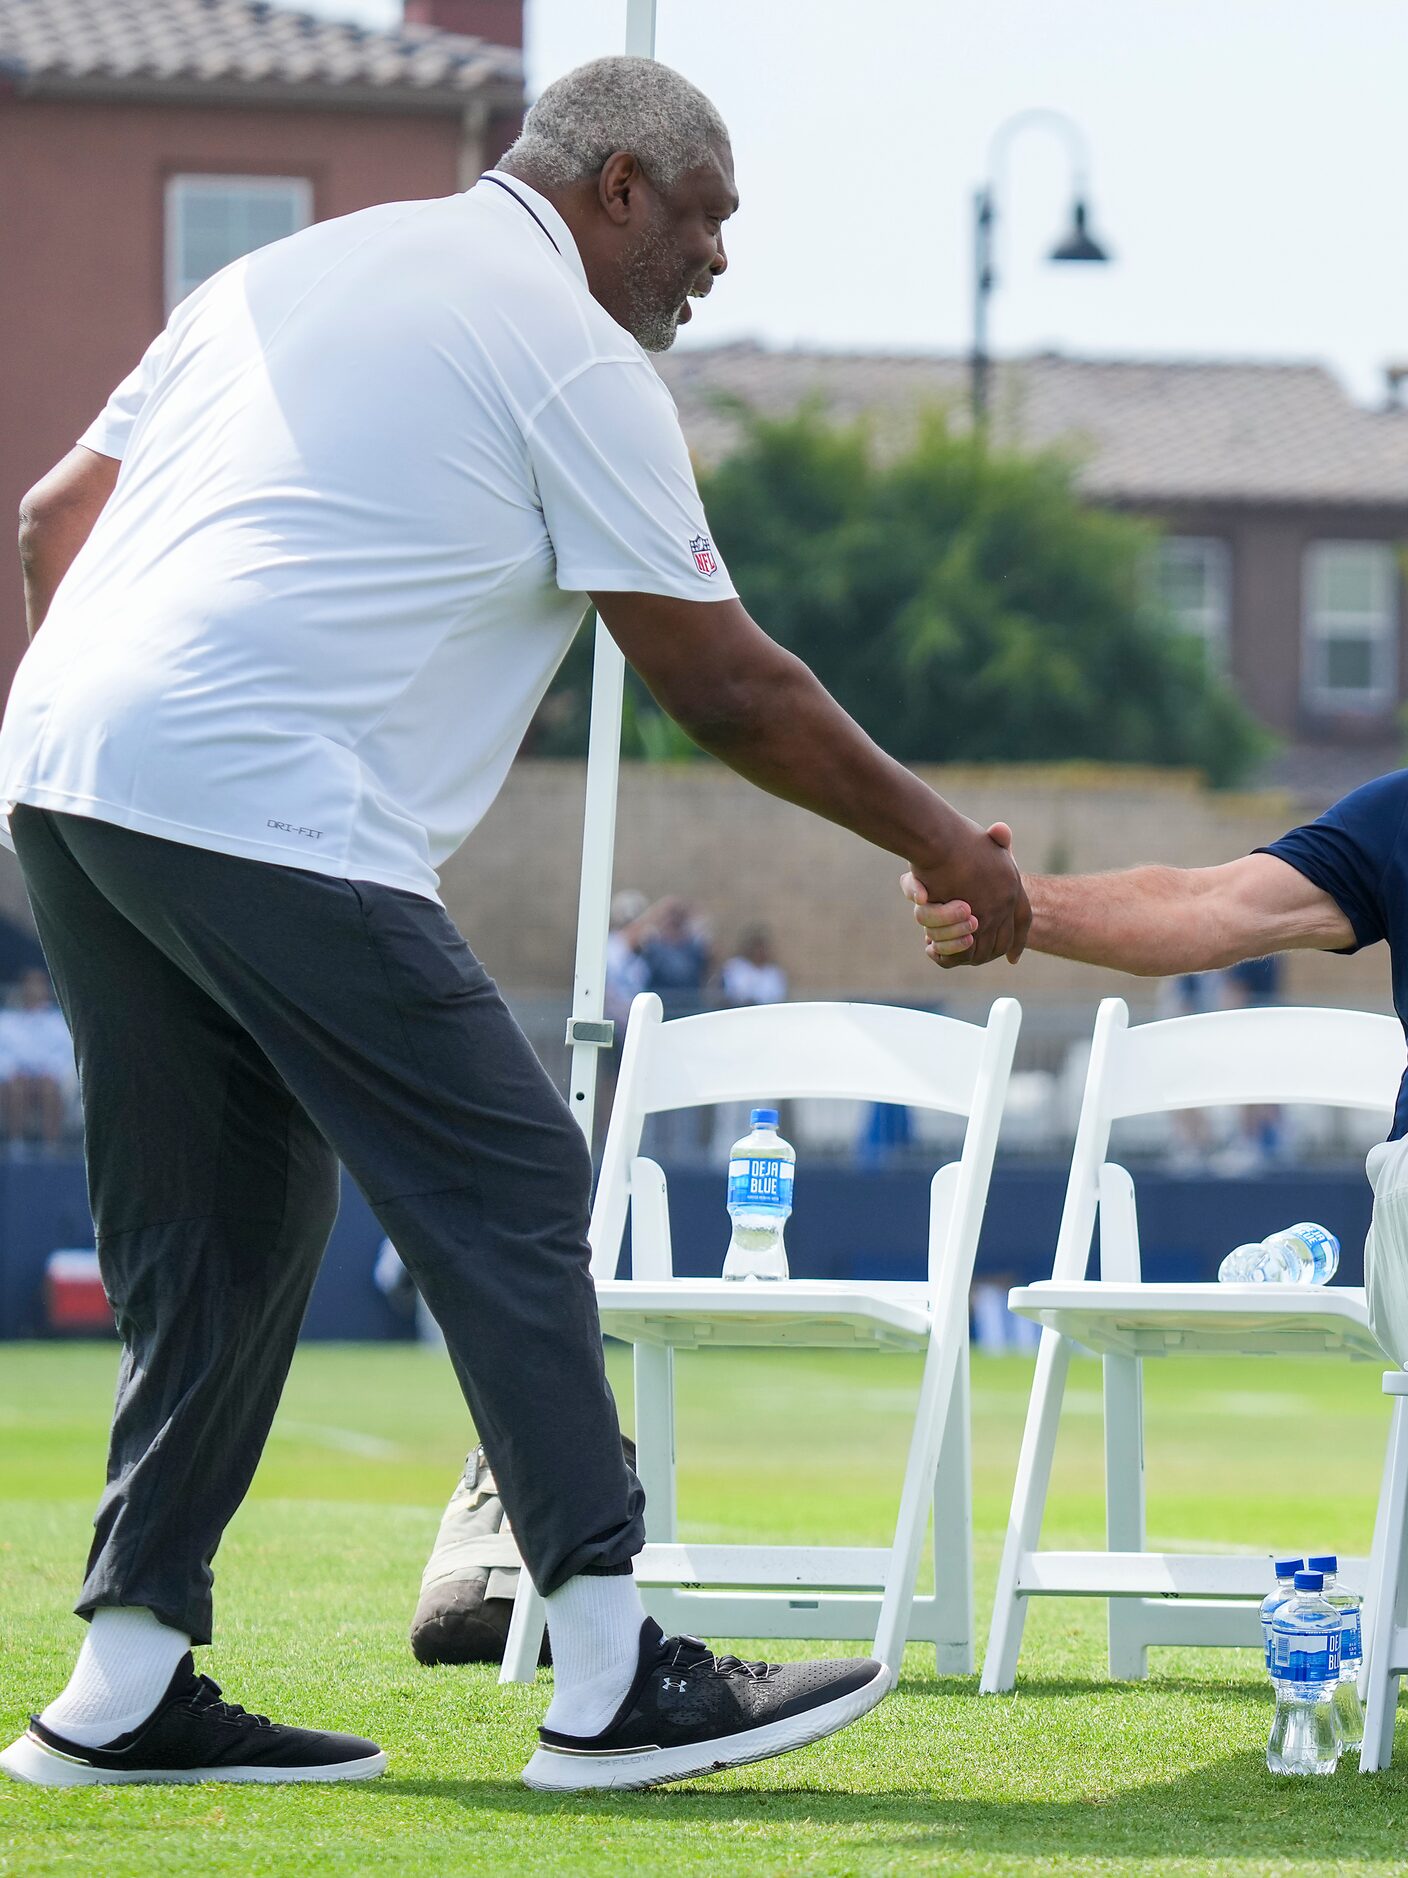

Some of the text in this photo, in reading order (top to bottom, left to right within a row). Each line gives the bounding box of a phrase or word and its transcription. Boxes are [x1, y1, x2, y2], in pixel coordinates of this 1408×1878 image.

[695, 552, 715, 572] NFL
[267, 819, 324, 839] DRI-FIT
[751, 1160, 779, 1177] DEJA
[750, 1177, 778, 1195] BLUE
